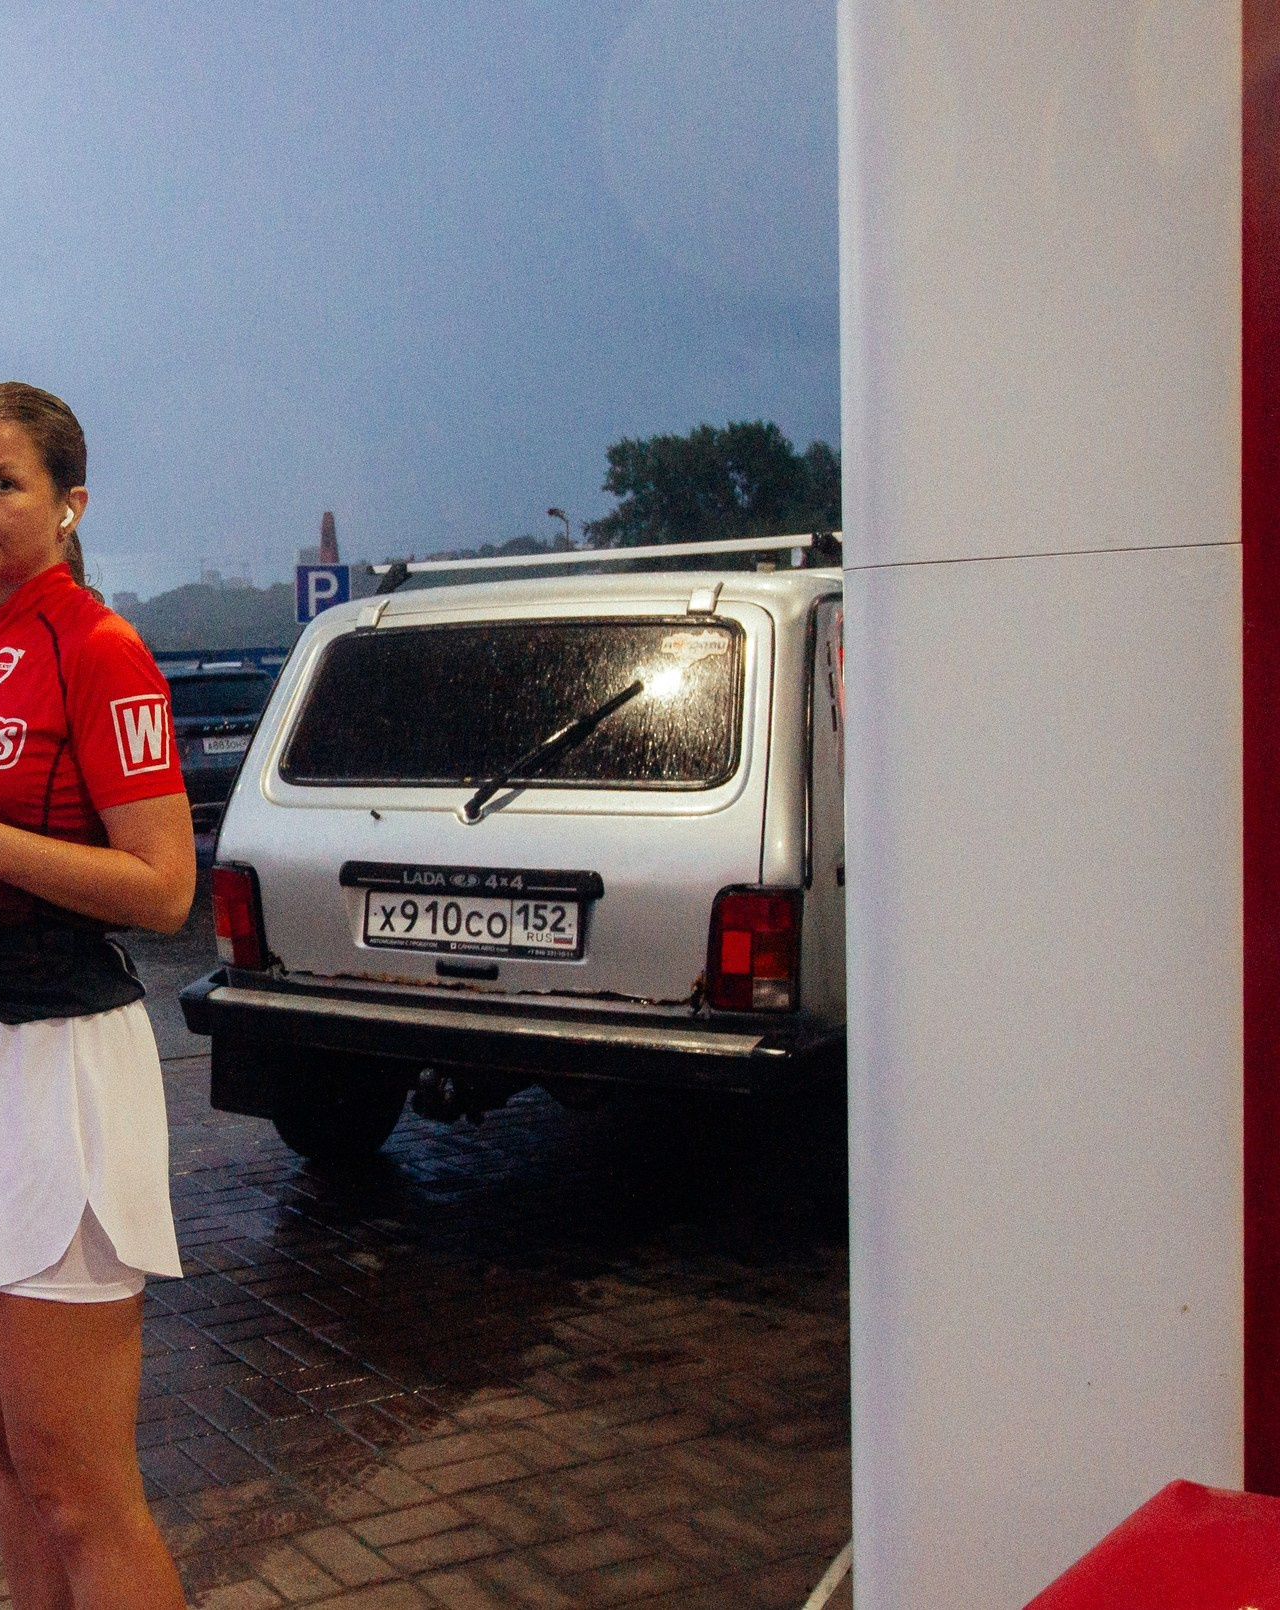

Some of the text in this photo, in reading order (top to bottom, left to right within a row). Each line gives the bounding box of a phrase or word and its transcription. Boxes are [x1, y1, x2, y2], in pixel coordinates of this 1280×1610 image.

[308, 571, 338, 617] P
[123, 704, 162, 764] W
[403, 871, 446, 886] LADA
[516, 904, 566, 933] 152
[526, 931, 553, 944] RUS
